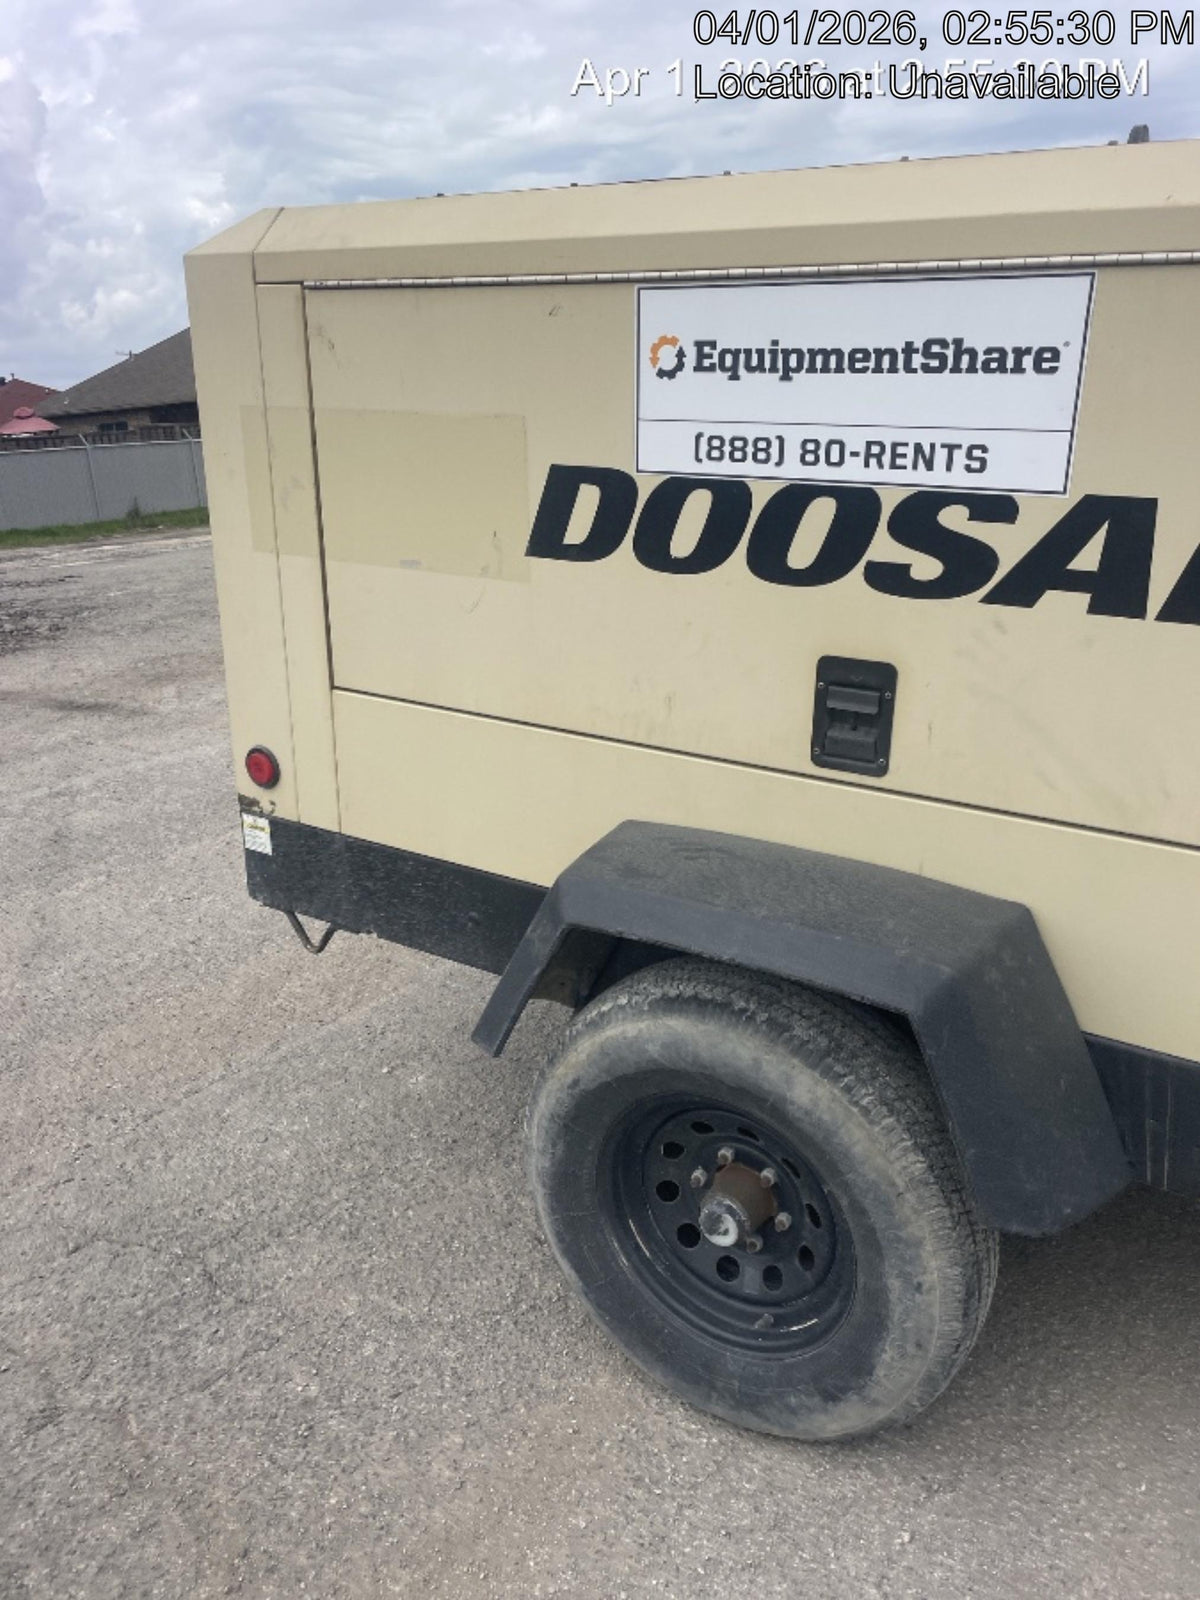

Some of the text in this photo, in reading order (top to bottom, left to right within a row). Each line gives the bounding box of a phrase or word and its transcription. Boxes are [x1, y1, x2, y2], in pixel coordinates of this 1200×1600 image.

[693, 338, 1061, 381] EquipmentShare
[693, 431, 989, 474] (888) 80-RENTS
[525, 464, 1200, 625] DOOSA
